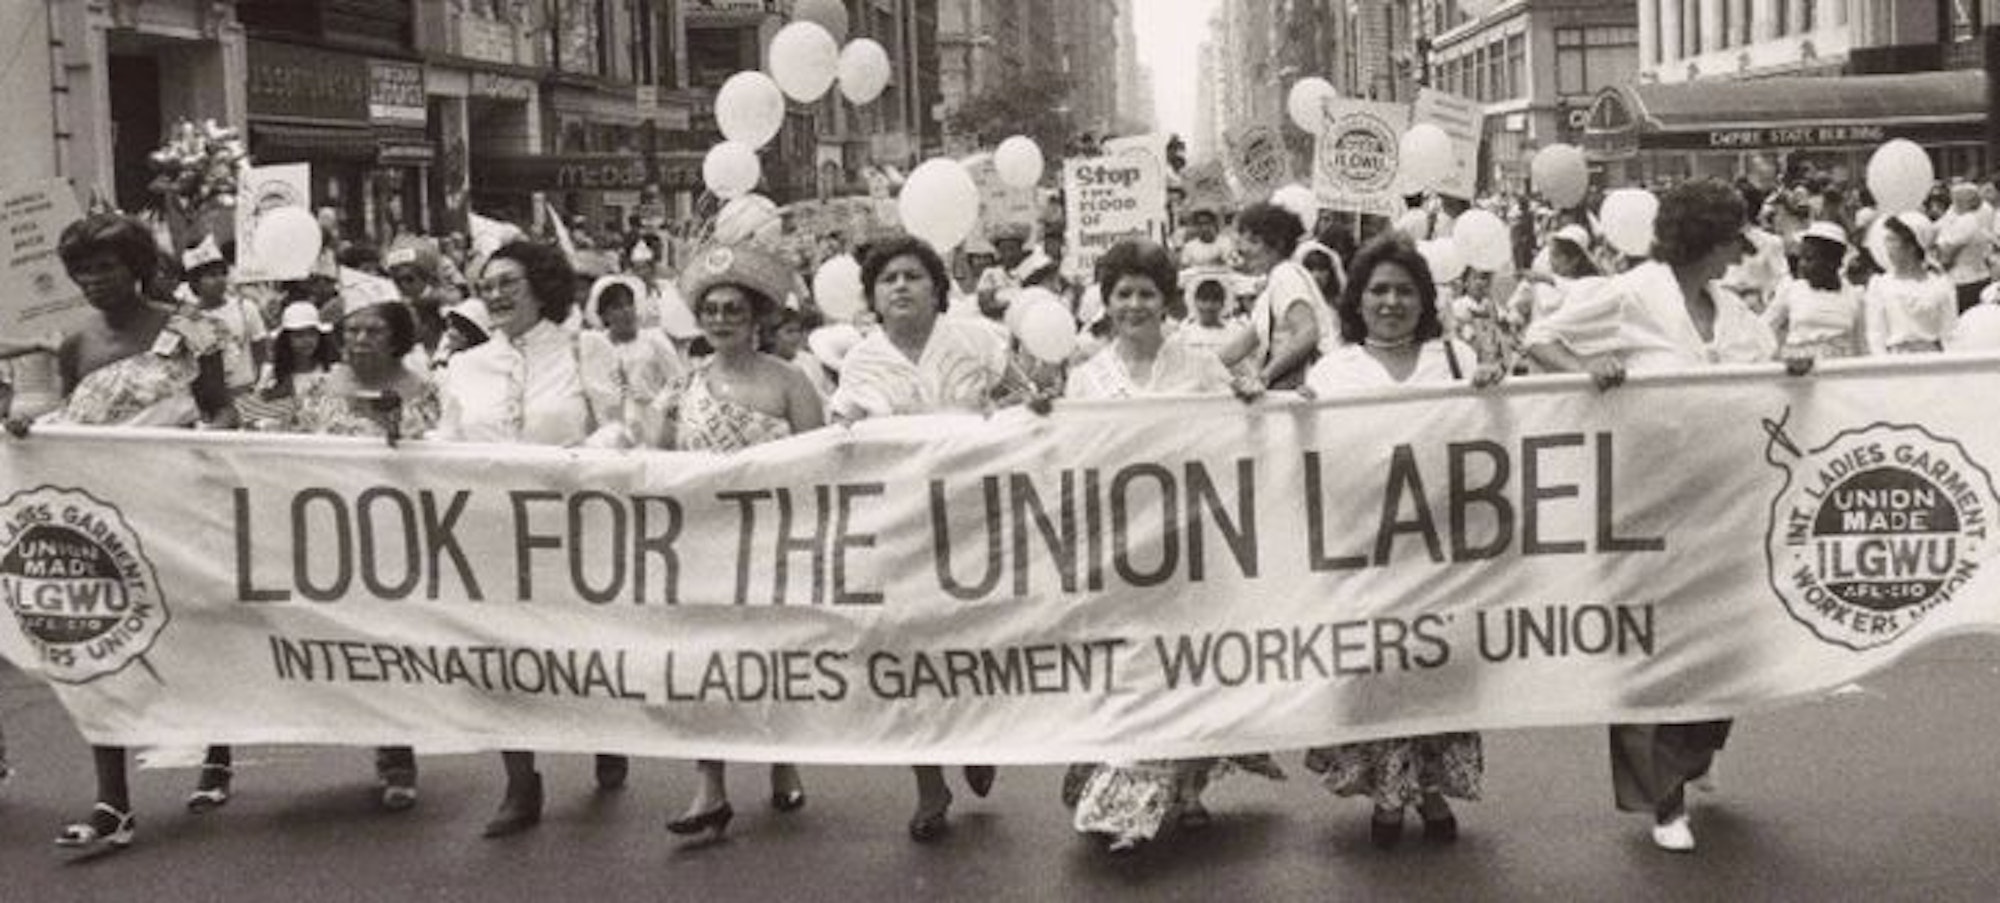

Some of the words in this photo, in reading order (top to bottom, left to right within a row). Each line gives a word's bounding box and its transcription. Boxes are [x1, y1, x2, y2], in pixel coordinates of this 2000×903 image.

[1710, 131, 1762, 146] EMPIRE
[1770, 128, 1814, 144] STATE
[1076, 165, 1141, 188] Stop
[1804, 442, 1887, 498] LADIES
[1894, 444, 1987, 541] GARMENT
[1833, 489, 1936, 509] UNION
[233, 486, 485, 602] LOOK
[508, 489, 684, 605] FOR
[715, 480, 885, 605] THE
[930, 457, 1259, 601] UNION
[1303, 431, 1666, 573] LABEL
[1842, 511, 1930, 531] MADE
[23, 558, 96, 577] MADE
[1817, 537, 1957, 579] ILGWU
[1792, 564, 1899, 635] WORKERS
[1844, 582, 1927, 598] AFL-CIO
[269, 634, 646, 698] INTERNATIONAL
[867, 637, 1127, 701] GARMENT
[1476, 603, 1655, 664] UNION
